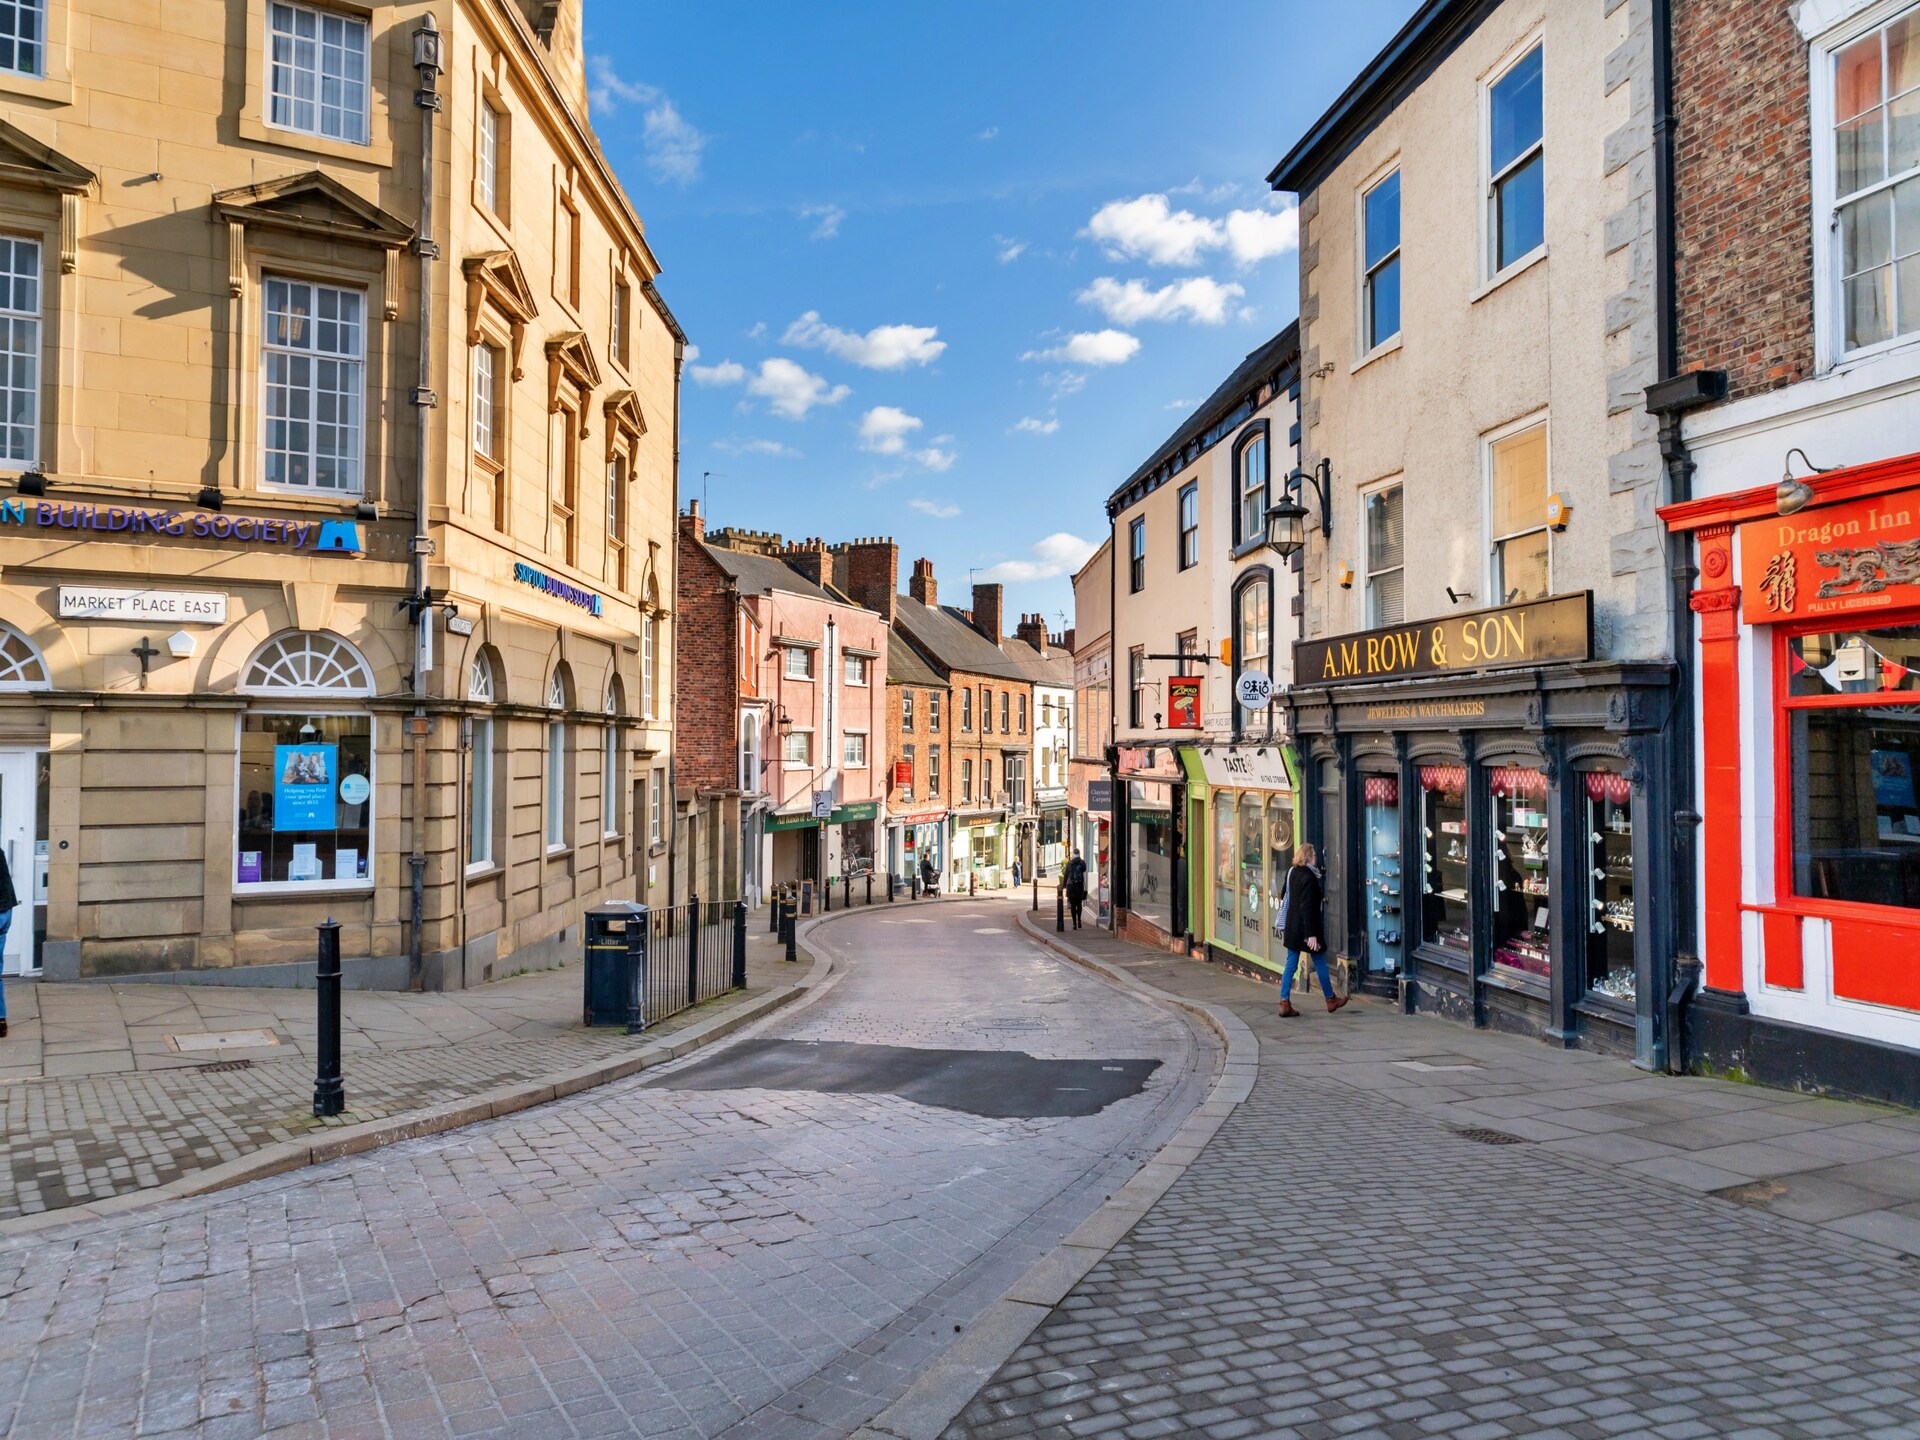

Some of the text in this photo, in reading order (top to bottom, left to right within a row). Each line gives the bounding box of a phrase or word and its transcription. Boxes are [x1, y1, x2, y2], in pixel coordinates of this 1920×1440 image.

[36, 502, 184, 536] BUILDING
[1778, 508, 1911, 547] Dragon Inn
[514, 562, 546, 590] SKIPTON
[64, 595, 220, 614] MARKET PLACE EAST
[1808, 595, 1892, 612] FULLY LICENSED
[1367, 630, 1422, 674] ROW
[1430, 626, 1448, 666] &
[1462, 612, 1526, 662] SON
[1367, 701, 1485, 720] JEWELLERS & WATCHMAKERS
[1223, 757, 1247, 773] TASTE
[1217, 908, 1231, 921] TASTE
[1243, 916, 1259, 931] TASTE
[1272, 926, 1283, 940] TAS
